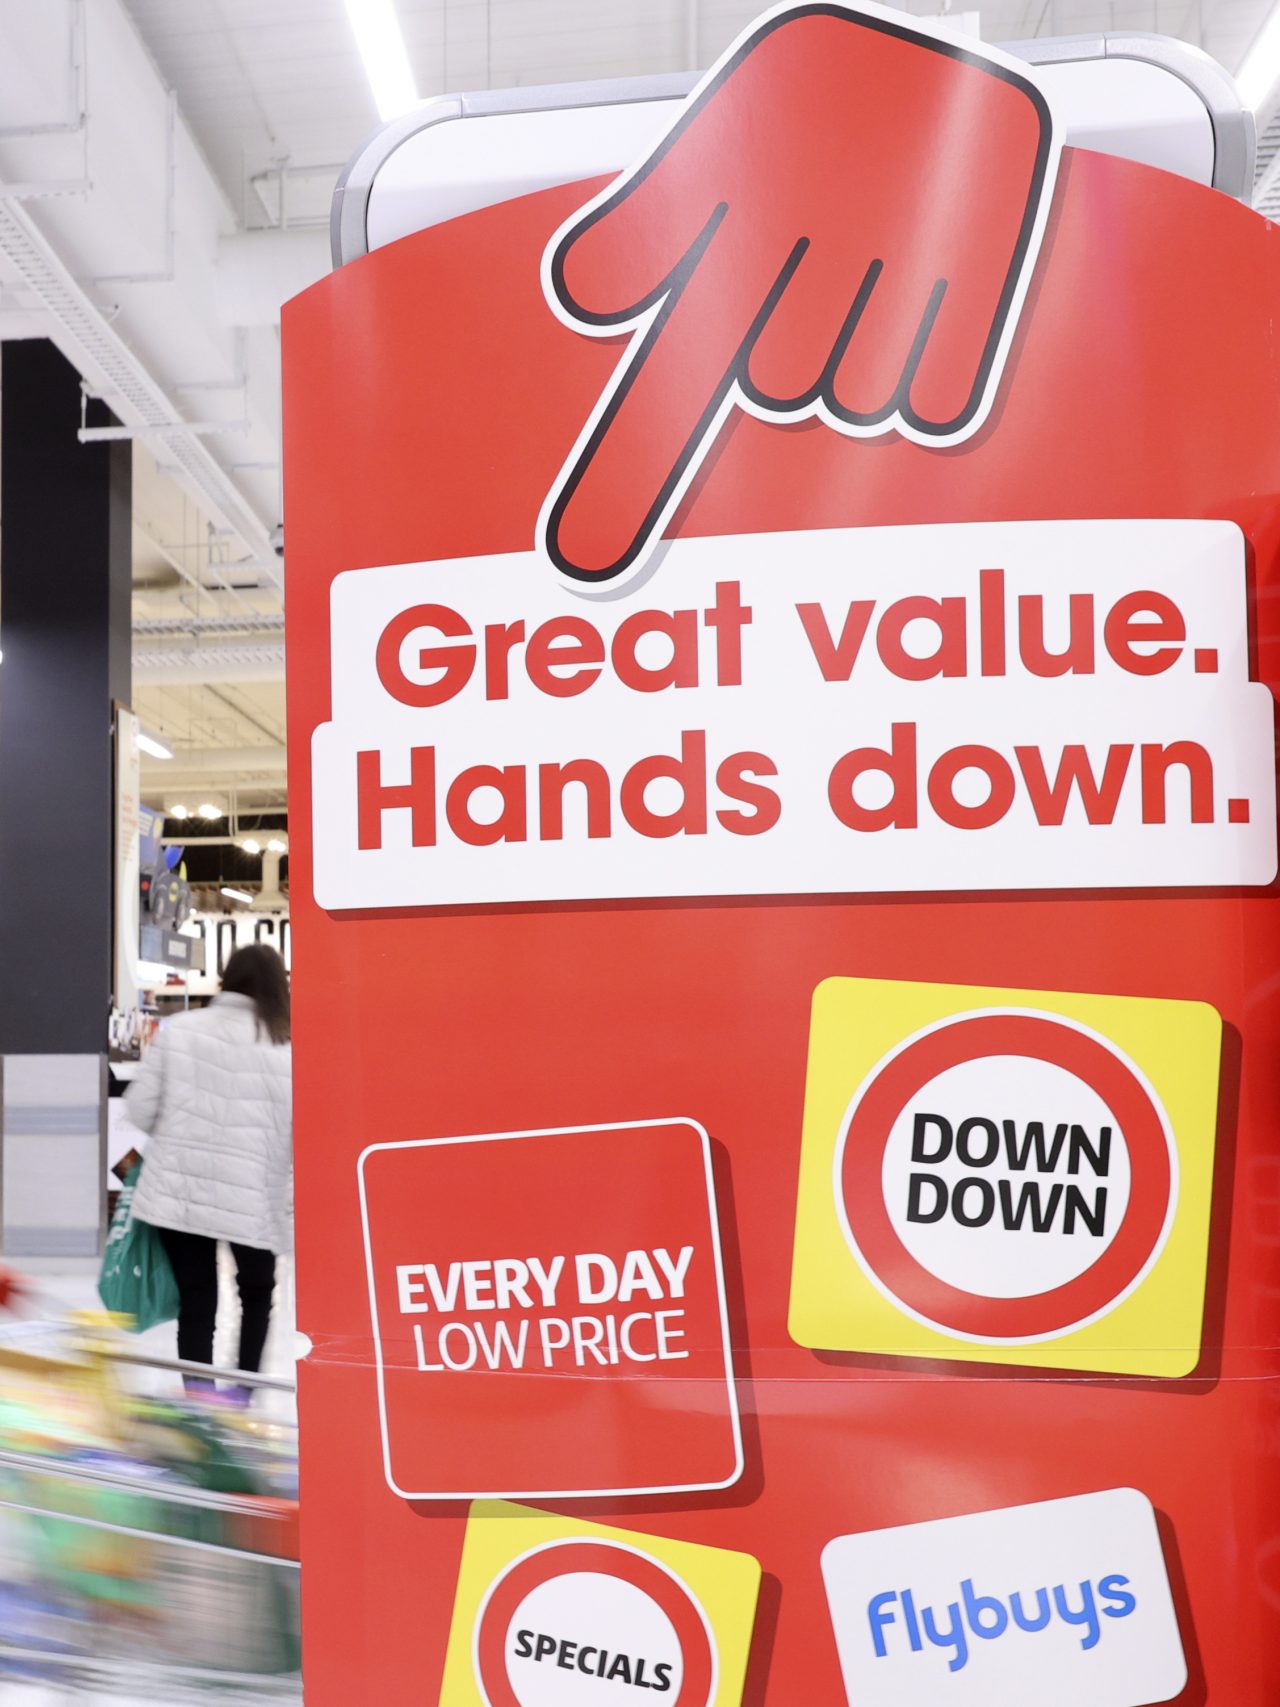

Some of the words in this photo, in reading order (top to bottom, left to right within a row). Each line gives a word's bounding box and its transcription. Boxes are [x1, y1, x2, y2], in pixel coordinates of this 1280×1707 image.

[375, 580, 754, 708] Great
[795, 568, 1220, 683] value.
[356, 729, 782, 851] Hands
[827, 722, 1251, 833] down.
[910, 1112, 1113, 1178] DOWN
[905, 1172, 1109, 1238] DOWN
[395, 1255, 566, 1315] EVERY
[573, 1245, 695, 1303] DAY
[411, 1318, 530, 1373] LOW
[538, 1308, 691, 1367] PRICE
[867, 1571, 1137, 1673] flybuys
[514, 1629, 673, 1692] SPECIALS
